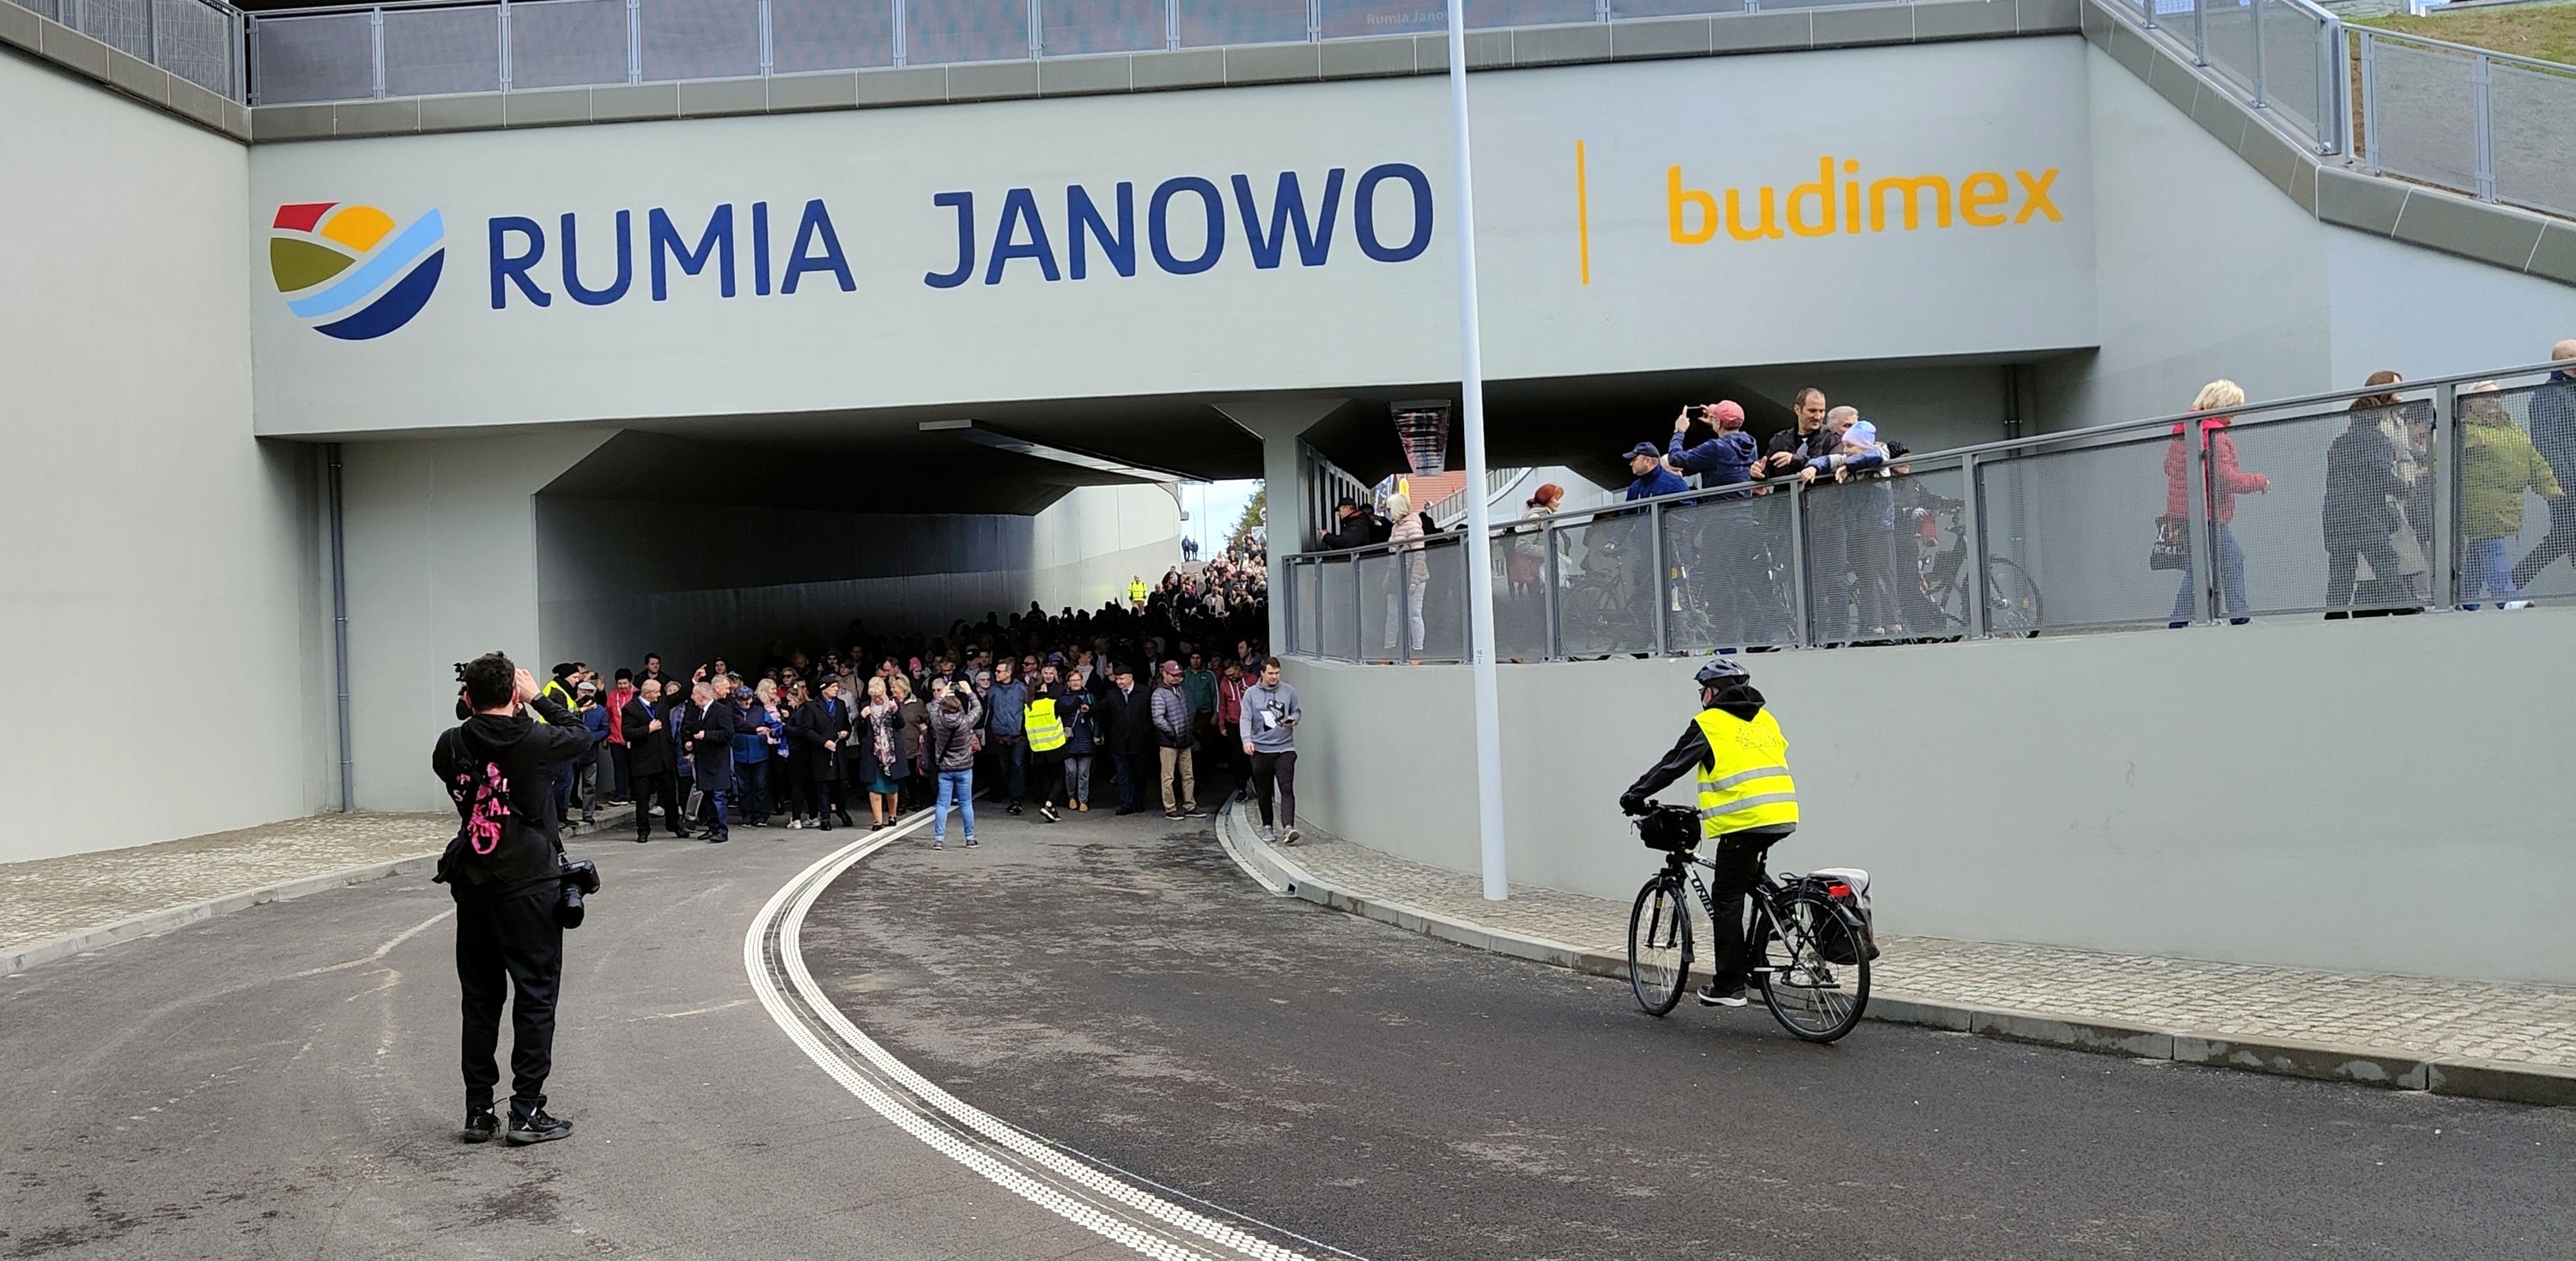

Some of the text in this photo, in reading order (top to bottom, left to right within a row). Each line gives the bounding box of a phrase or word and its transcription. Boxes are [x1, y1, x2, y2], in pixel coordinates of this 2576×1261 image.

[1366, 9, 1465, 25] Rumia Jano
[1668, 155, 2063, 246] budimex
[489, 164, 1434, 310] RUMIA JANOWO
[1691, 877, 1716, 921] UNIBI
